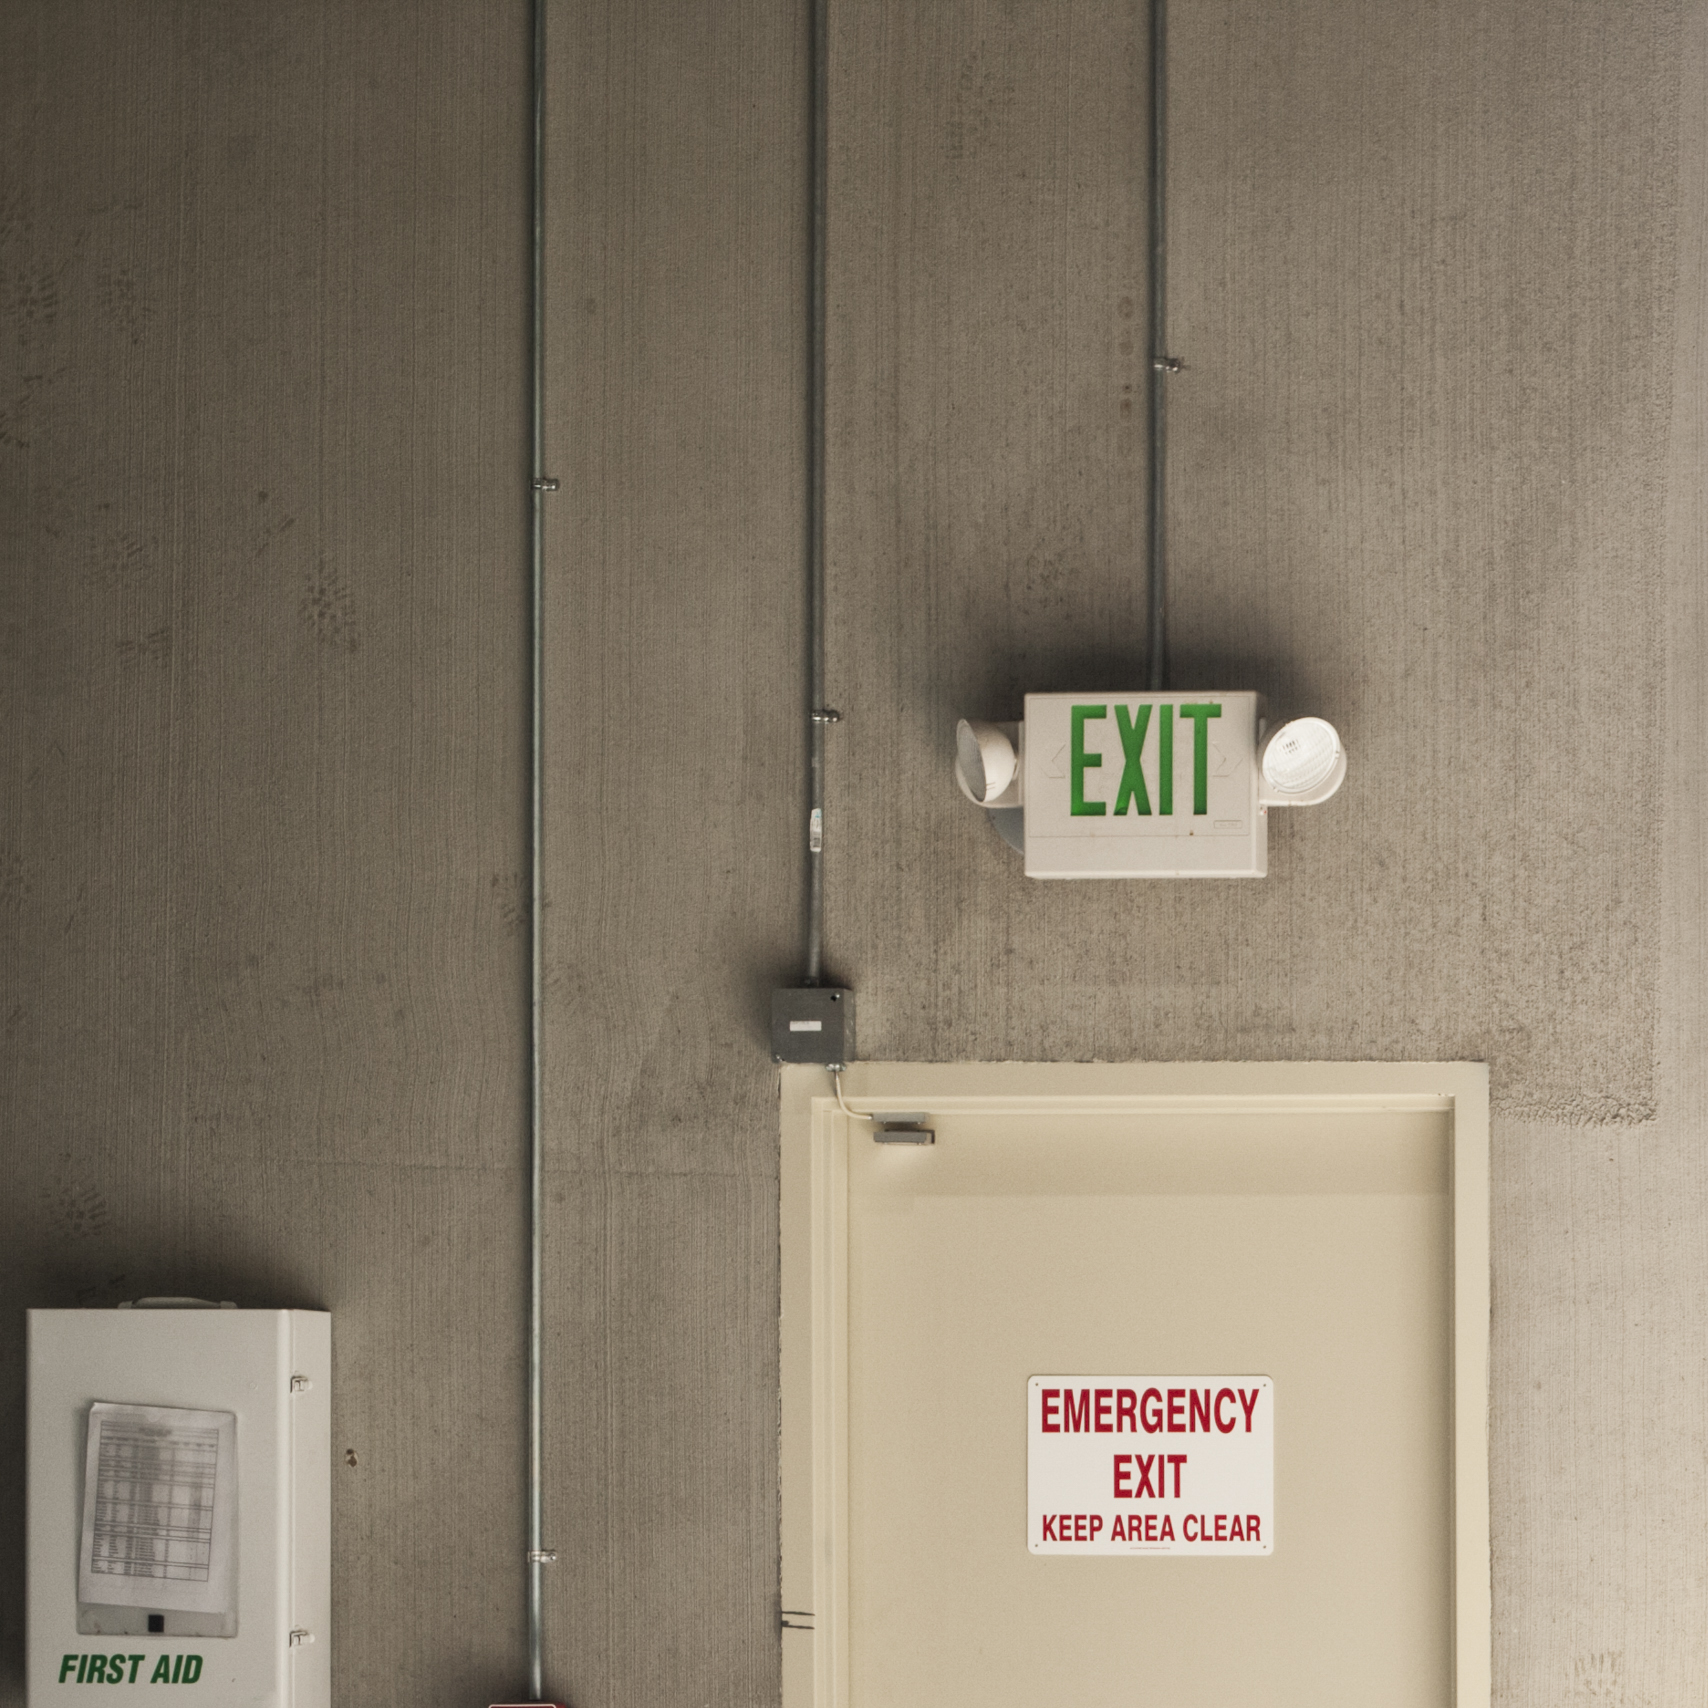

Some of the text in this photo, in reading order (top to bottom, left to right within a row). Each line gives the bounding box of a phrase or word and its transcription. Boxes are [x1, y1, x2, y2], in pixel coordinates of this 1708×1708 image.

[1070, 704, 1222, 816] EXIT
[1041, 1388, 1259, 1434] EMERGENCY
[1113, 1454, 1188, 1499] EXIT
[1042, 1514, 1261, 1541] KEEP AREA CLEAR
[58, 1654, 203, 1685] FIRST AID
